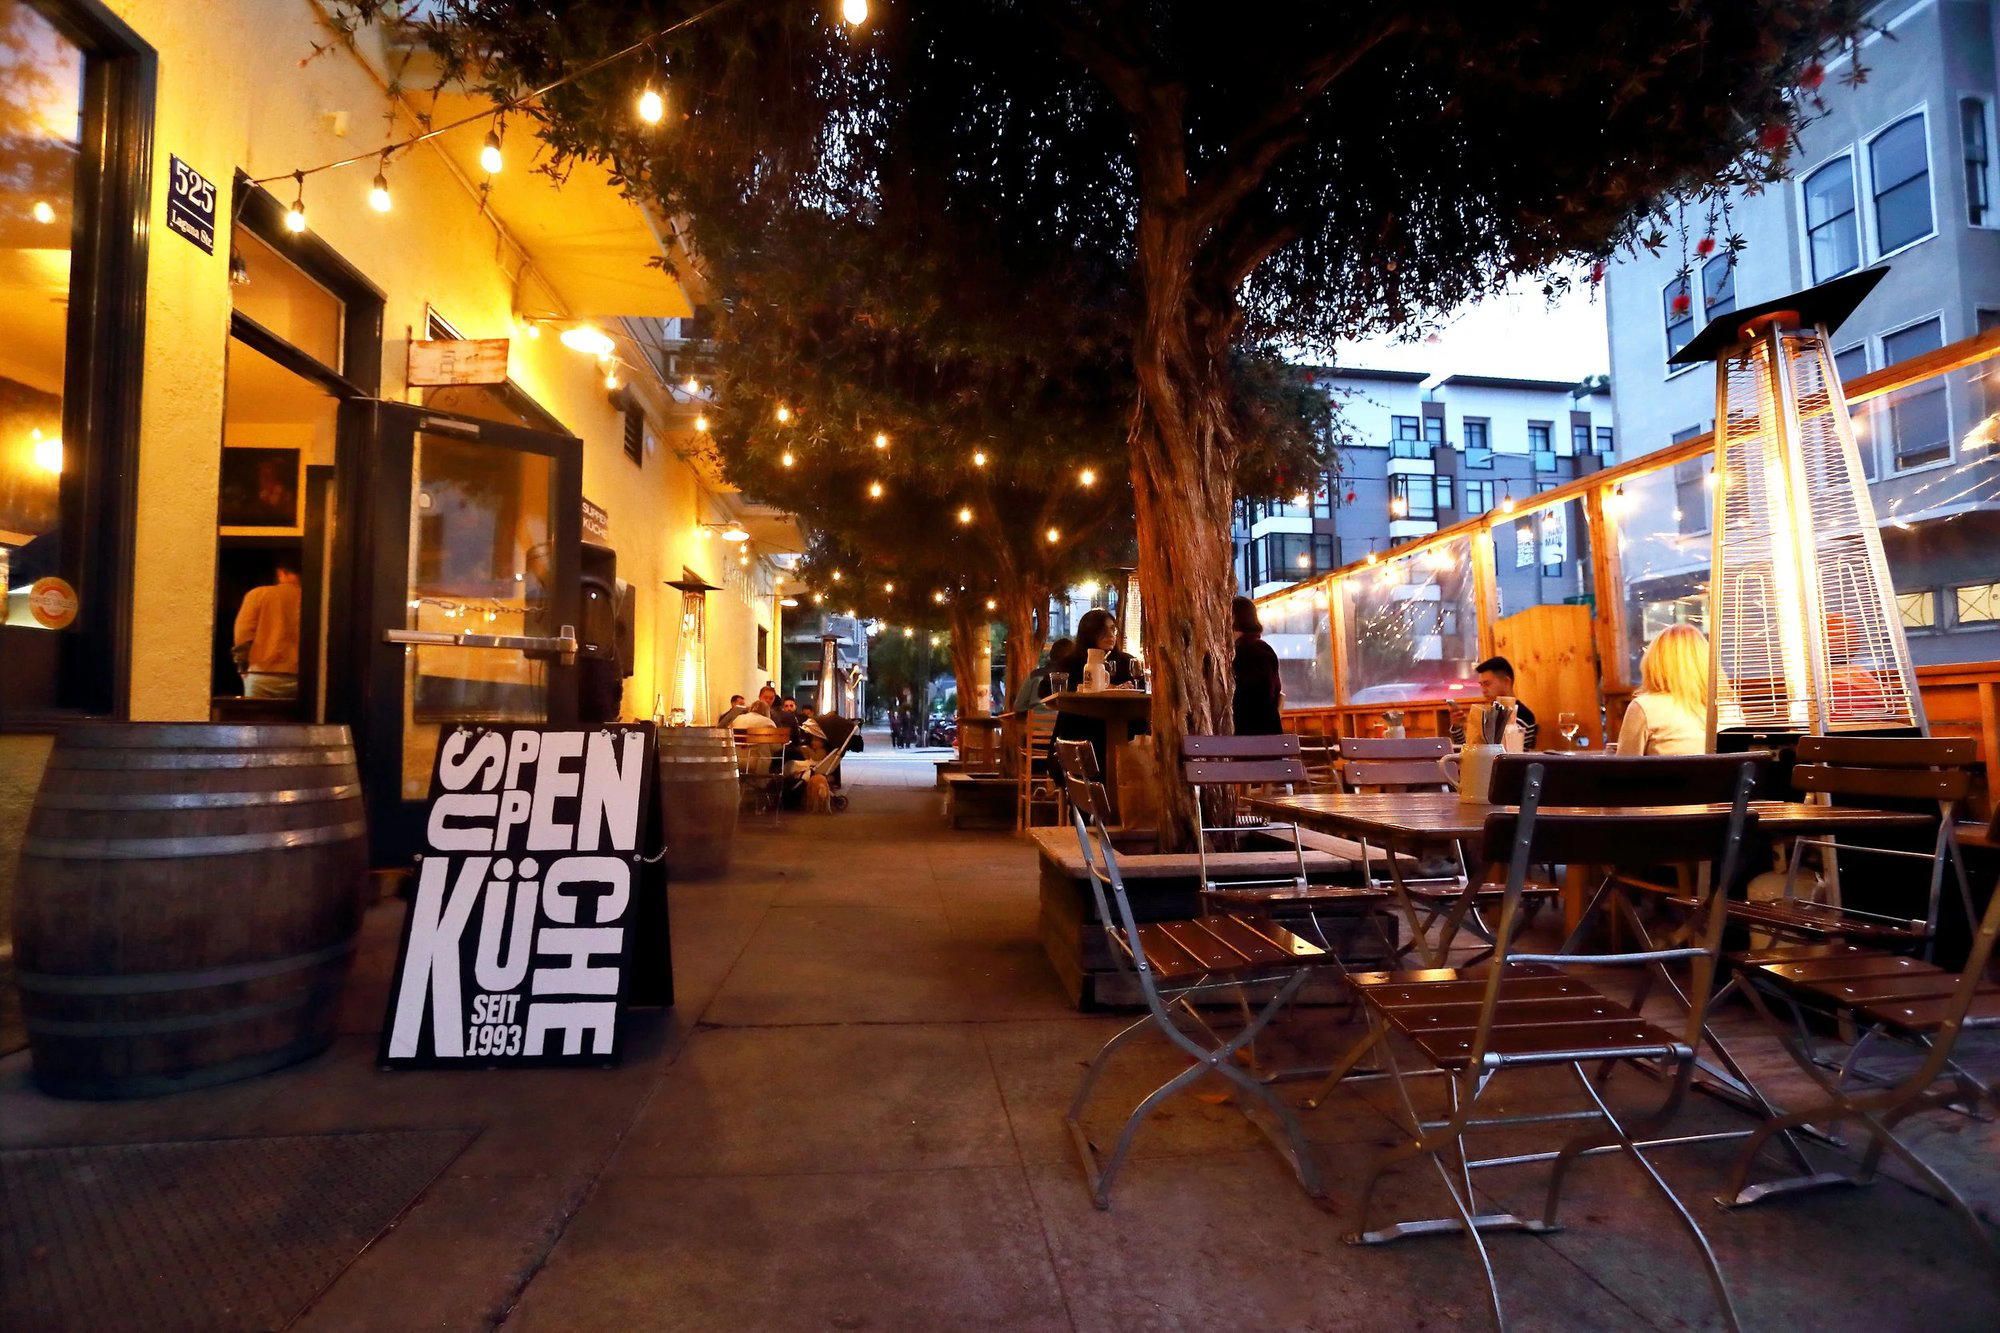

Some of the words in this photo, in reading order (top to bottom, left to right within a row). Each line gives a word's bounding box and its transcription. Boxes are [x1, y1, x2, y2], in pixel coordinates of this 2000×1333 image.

[175, 161, 213, 213] 525
[172, 209, 200, 240] Laguna
[427, 730, 645, 850] SUPPEN
[388, 856, 631, 1058] KÜCHE
[470, 994, 521, 1024] SEIT
[465, 1024, 522, 1057] 1993
